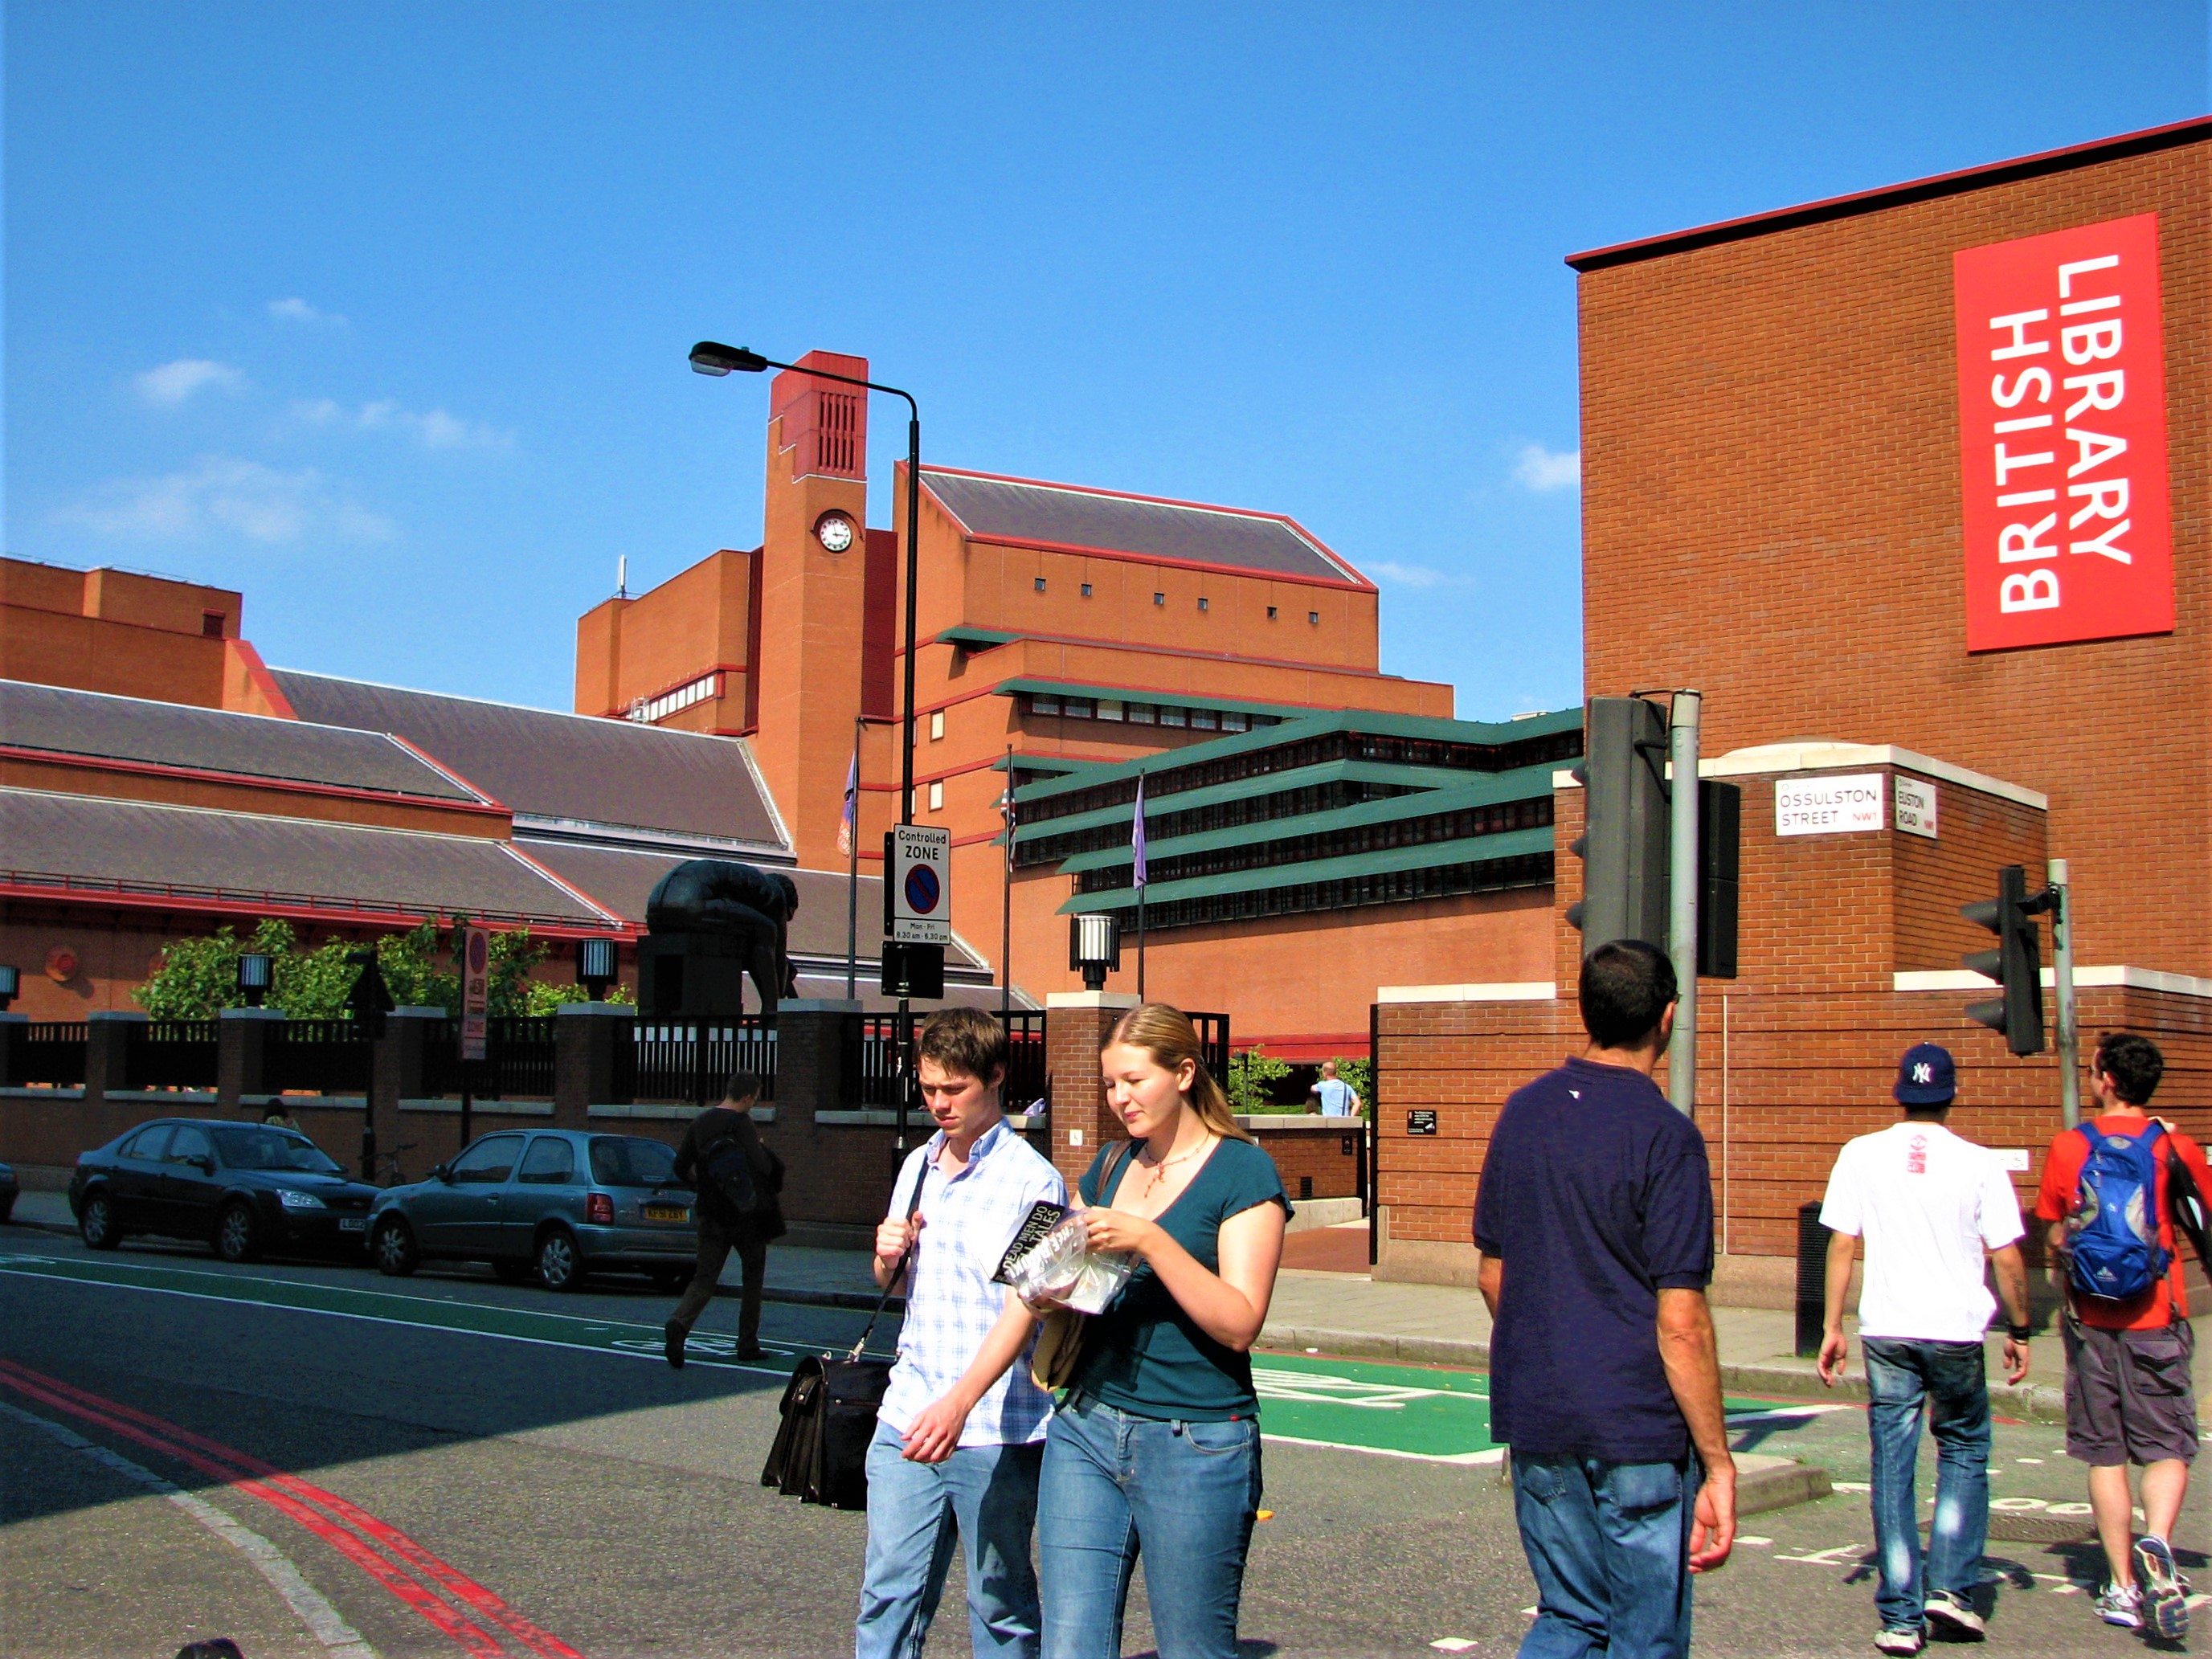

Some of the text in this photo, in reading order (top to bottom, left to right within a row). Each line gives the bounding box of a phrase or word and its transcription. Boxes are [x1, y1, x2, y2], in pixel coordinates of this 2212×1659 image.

[2058, 255, 2132, 565] LIBRARY
[1989, 309, 2060, 614] BRITISH
[1780, 790, 1877, 807] OSSULSTON
[1899, 791, 1924, 810] EUSTON
[1782, 811, 1877, 826] STREET NW1
[1899, 810, 1917, 826] ROAD
[898, 830, 947, 844] Controlled
[906, 845, 939, 860] ZONE
[1912, 1062, 1931, 1083] NY
[1028, 1210, 1061, 1242] TALES
[1003, 1242, 1024, 1269] DEAD
[1021, 1221, 1039, 1242] MEN
[1032, 1206, 1048, 1221] DO
